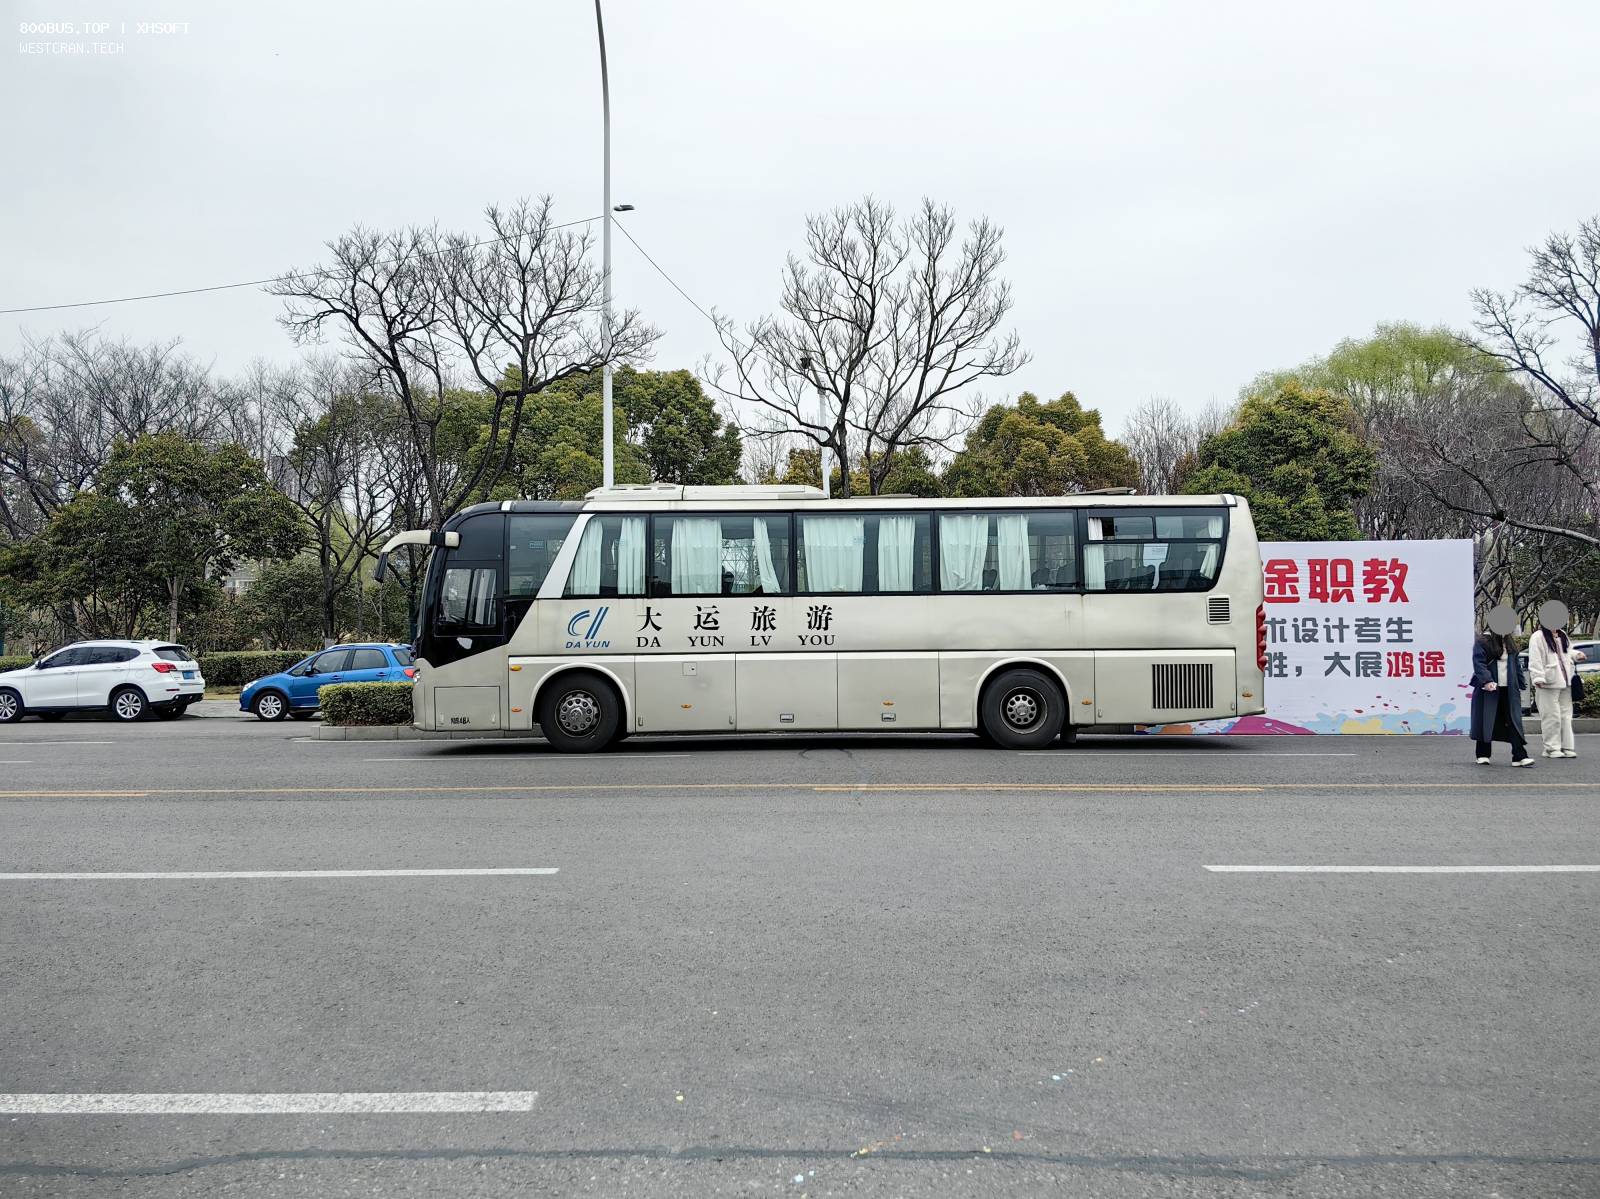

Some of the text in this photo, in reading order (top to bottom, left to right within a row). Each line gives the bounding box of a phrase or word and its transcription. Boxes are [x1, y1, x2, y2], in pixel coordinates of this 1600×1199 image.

[636, 605, 834, 632] 大运旅游
[1265, 617, 1413, 643] 术设计考生
[637, 634, 836, 648] DA YUN LV YOU
